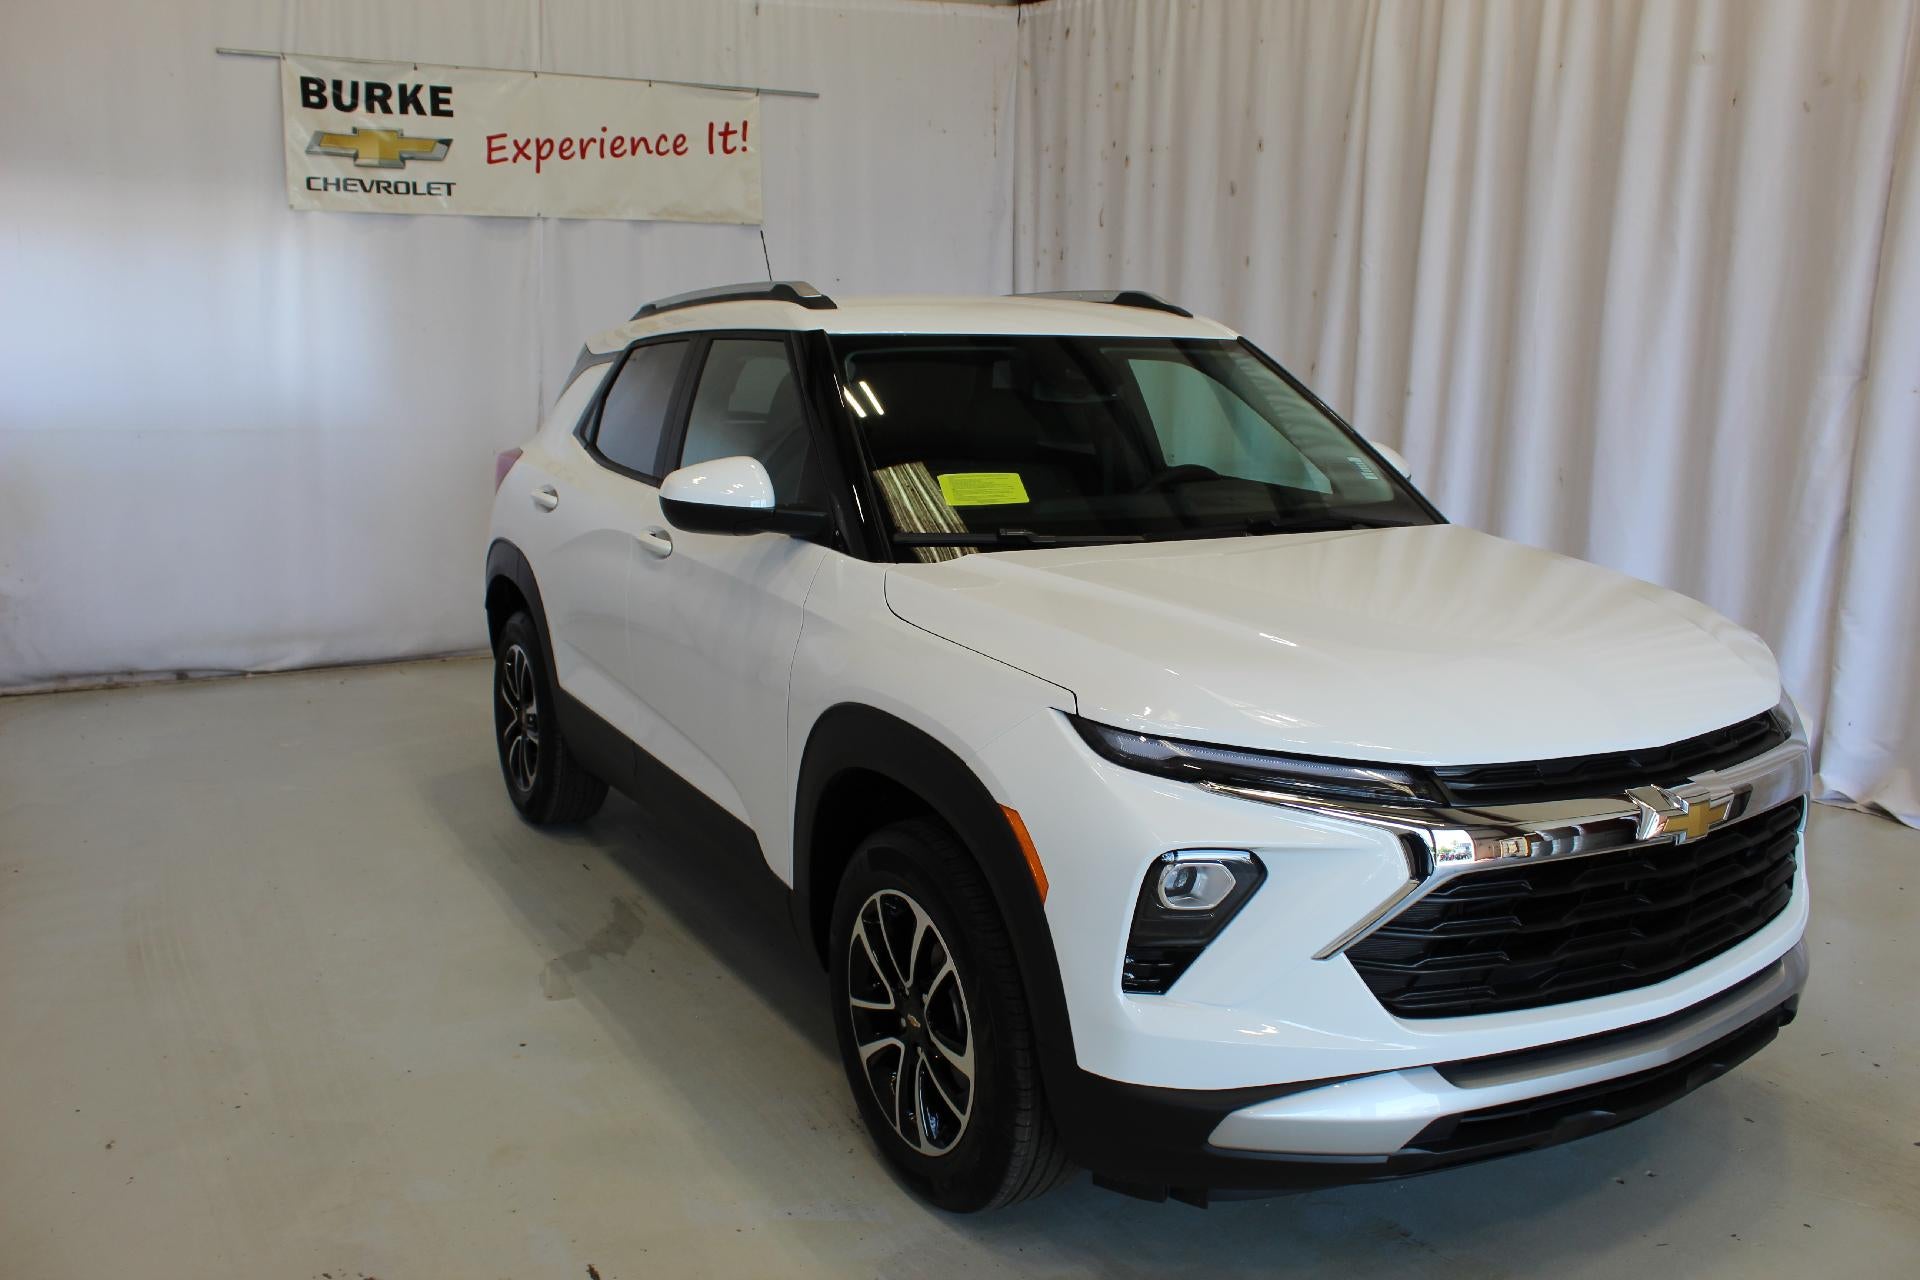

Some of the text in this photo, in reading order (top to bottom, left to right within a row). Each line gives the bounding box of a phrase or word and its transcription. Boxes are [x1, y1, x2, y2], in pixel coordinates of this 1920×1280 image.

[299, 76, 454, 117] BURKE
[485, 120, 749, 174] Experience It!
[305, 176, 457, 197] CHEVROLET
